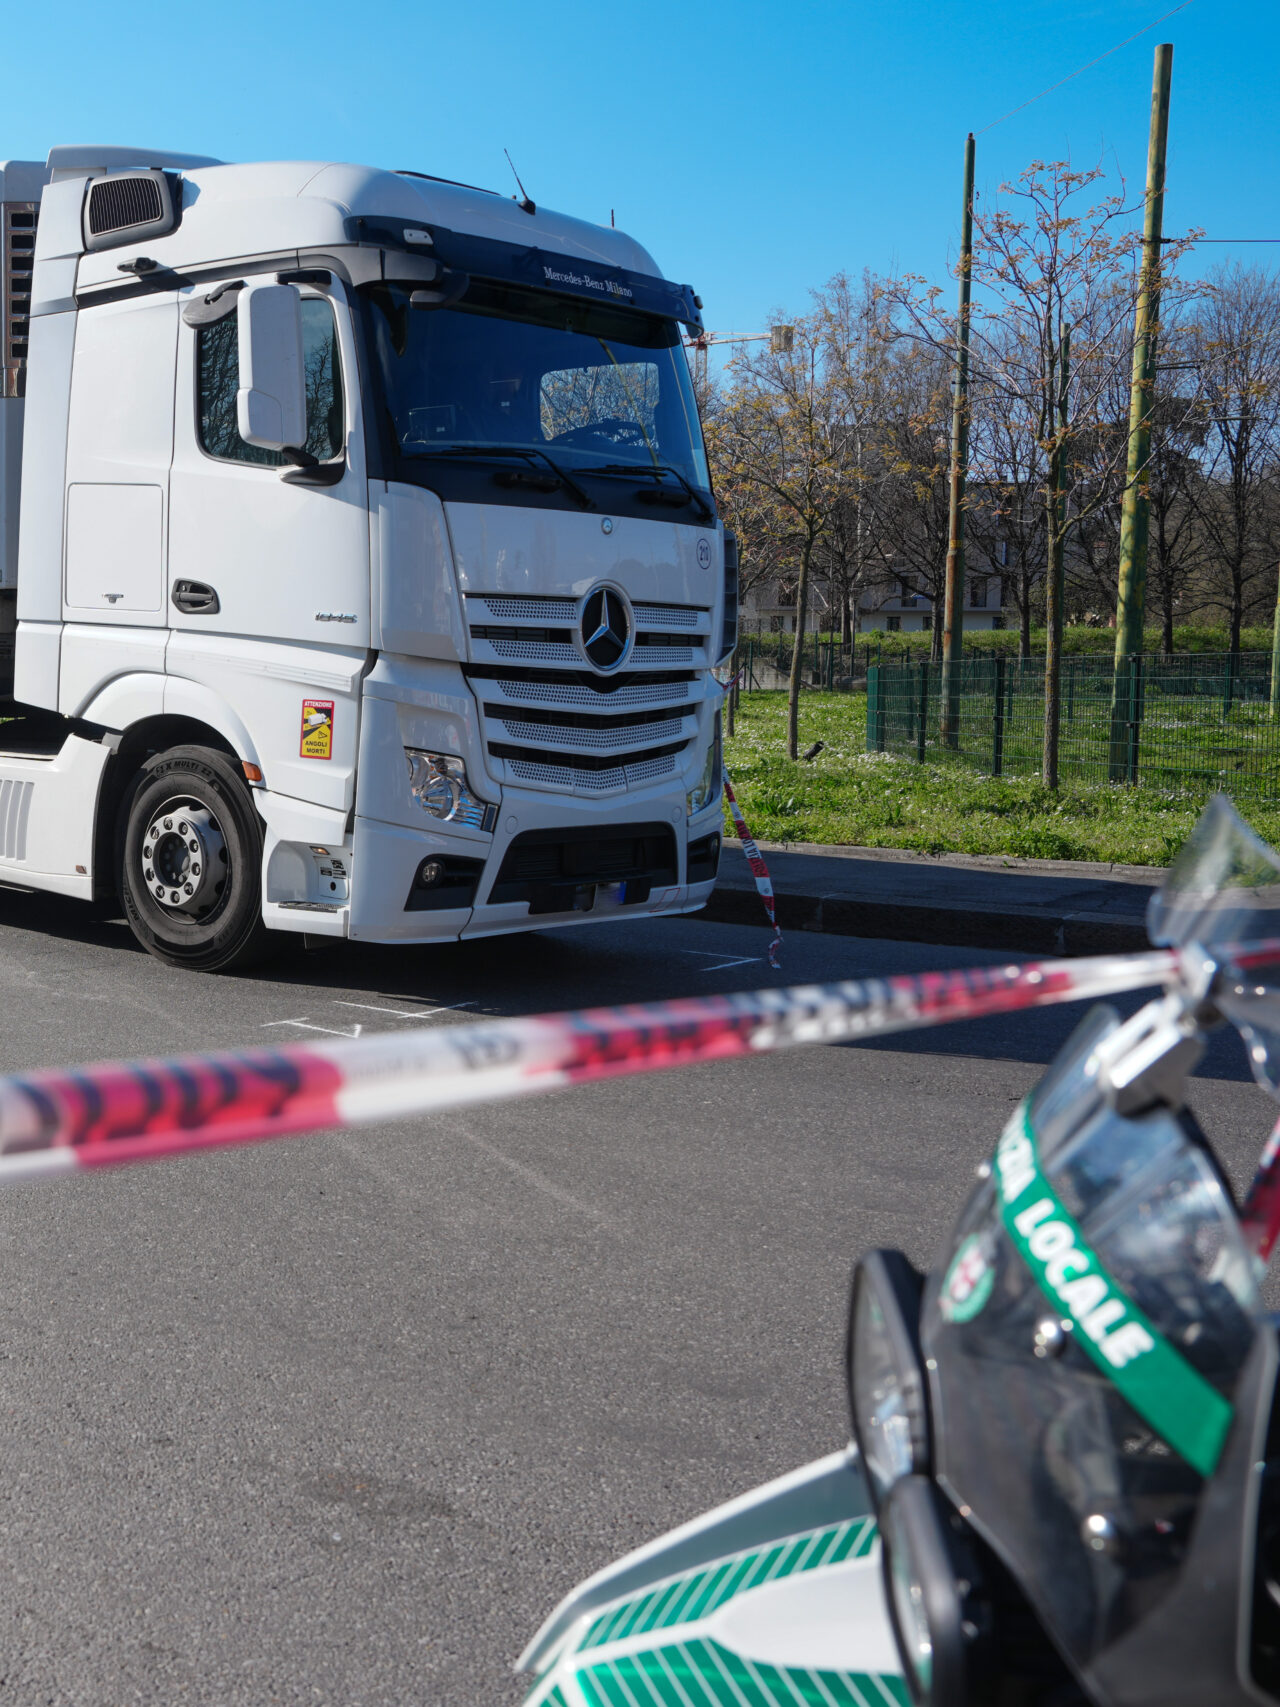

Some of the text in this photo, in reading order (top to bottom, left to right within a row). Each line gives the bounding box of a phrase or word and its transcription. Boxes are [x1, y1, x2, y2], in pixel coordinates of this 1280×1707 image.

[543, 266, 633, 298] Mercedes-Benz Milano
[305, 740, 328, 748] ANGOLI
[173, 760, 200, 769] MULTI
[1014, 1197, 1156, 1369] LOCALE
